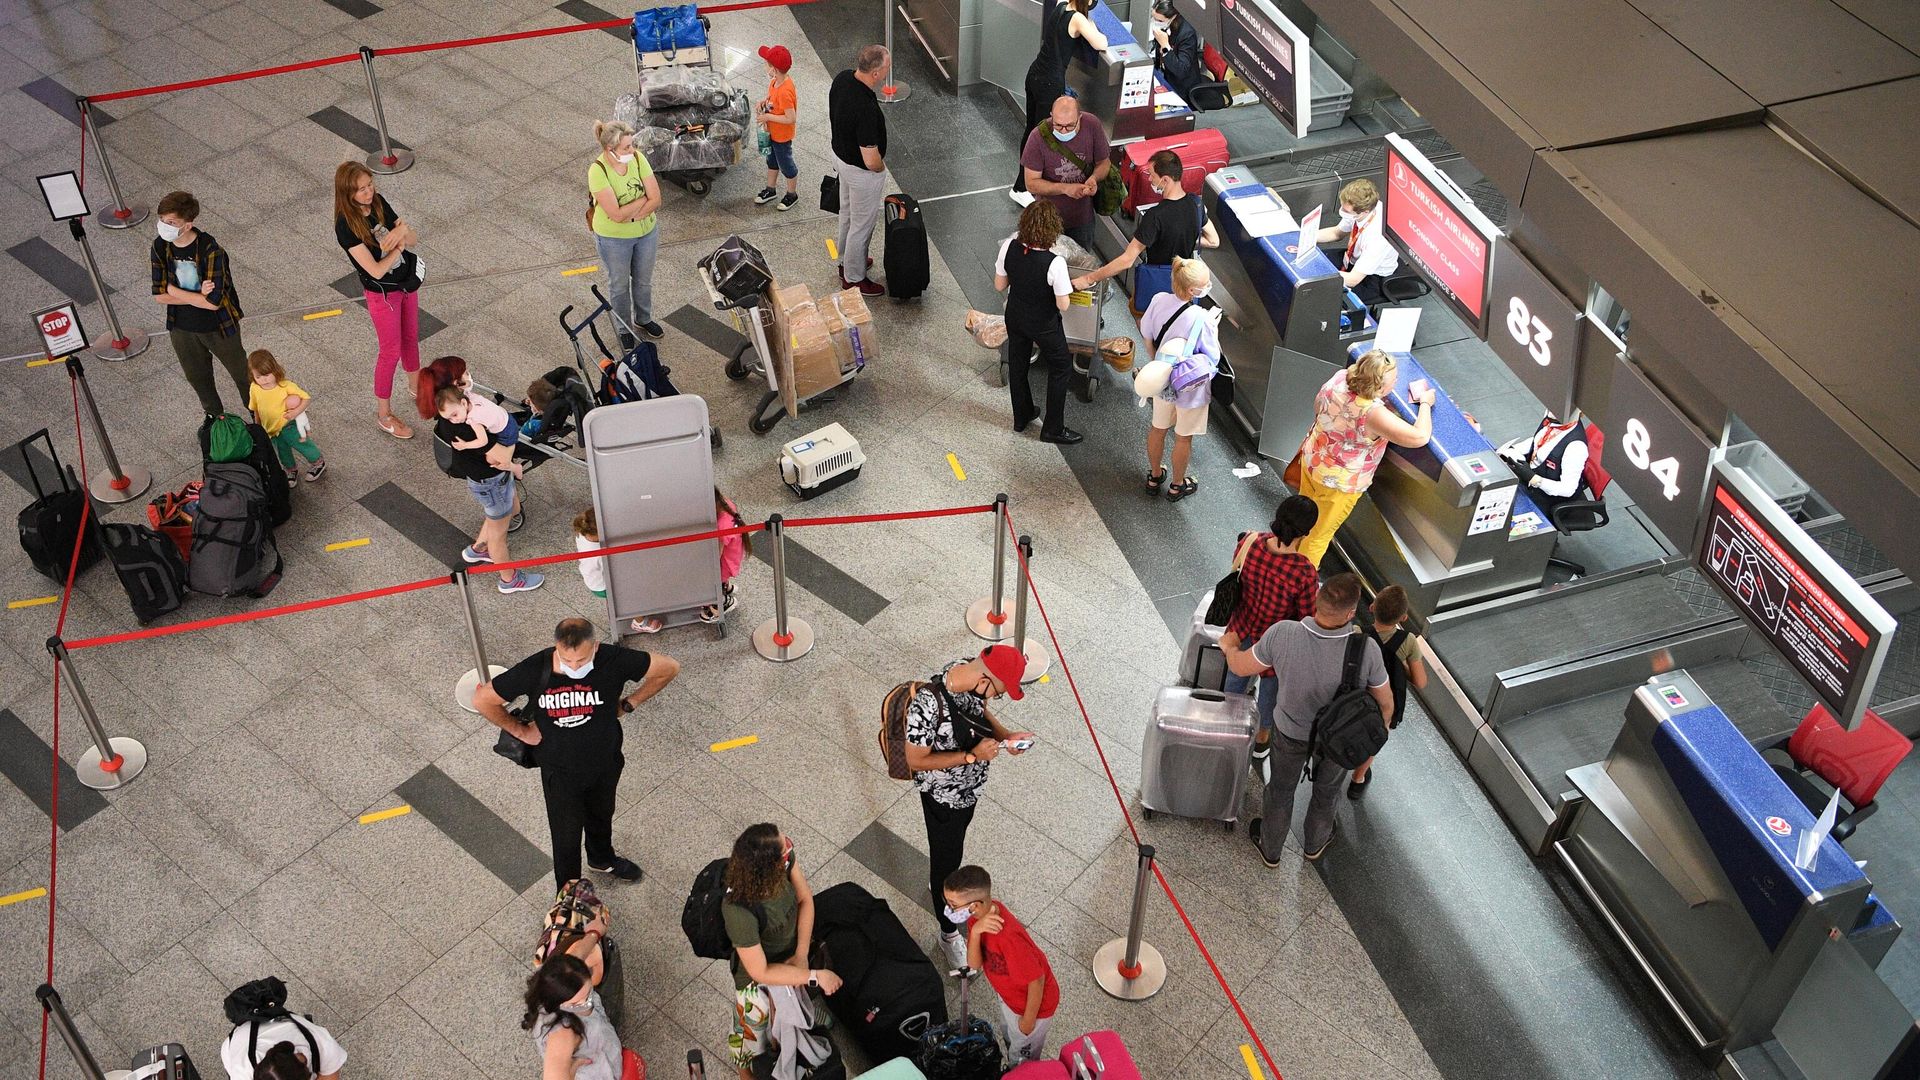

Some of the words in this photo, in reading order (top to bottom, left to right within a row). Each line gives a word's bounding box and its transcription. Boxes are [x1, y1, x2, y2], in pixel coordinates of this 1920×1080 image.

[1235, 0, 1261, 33] TURKISH
[1261, 27, 1288, 60] AIRLINES
[1238, 38, 1260, 65] BUSINESS
[1260, 61, 1276, 80] CLASS
[1408, 220, 1440, 255] ECONOMY
[1440, 252, 1460, 276] CLASS
[1410, 181, 1443, 220] TURKISH
[1444, 216, 1481, 257] AIRLINES
[1408, 248, 1423, 267] STAR
[1422, 262, 1450, 294] ALLIANCE
[42, 316, 68, 332] STOP
[1506, 296, 1553, 367] 83
[1622, 417, 1681, 501] 84
[1736, 509, 1765, 541] ПРАВИЛА
[1765, 539, 1795, 572] ПРОВОЗА
[1795, 568, 1824, 598] РУЧНОЙ
[1822, 597, 1846, 623] КЛАДИ
[538, 691, 604, 709] ORIGINAL
